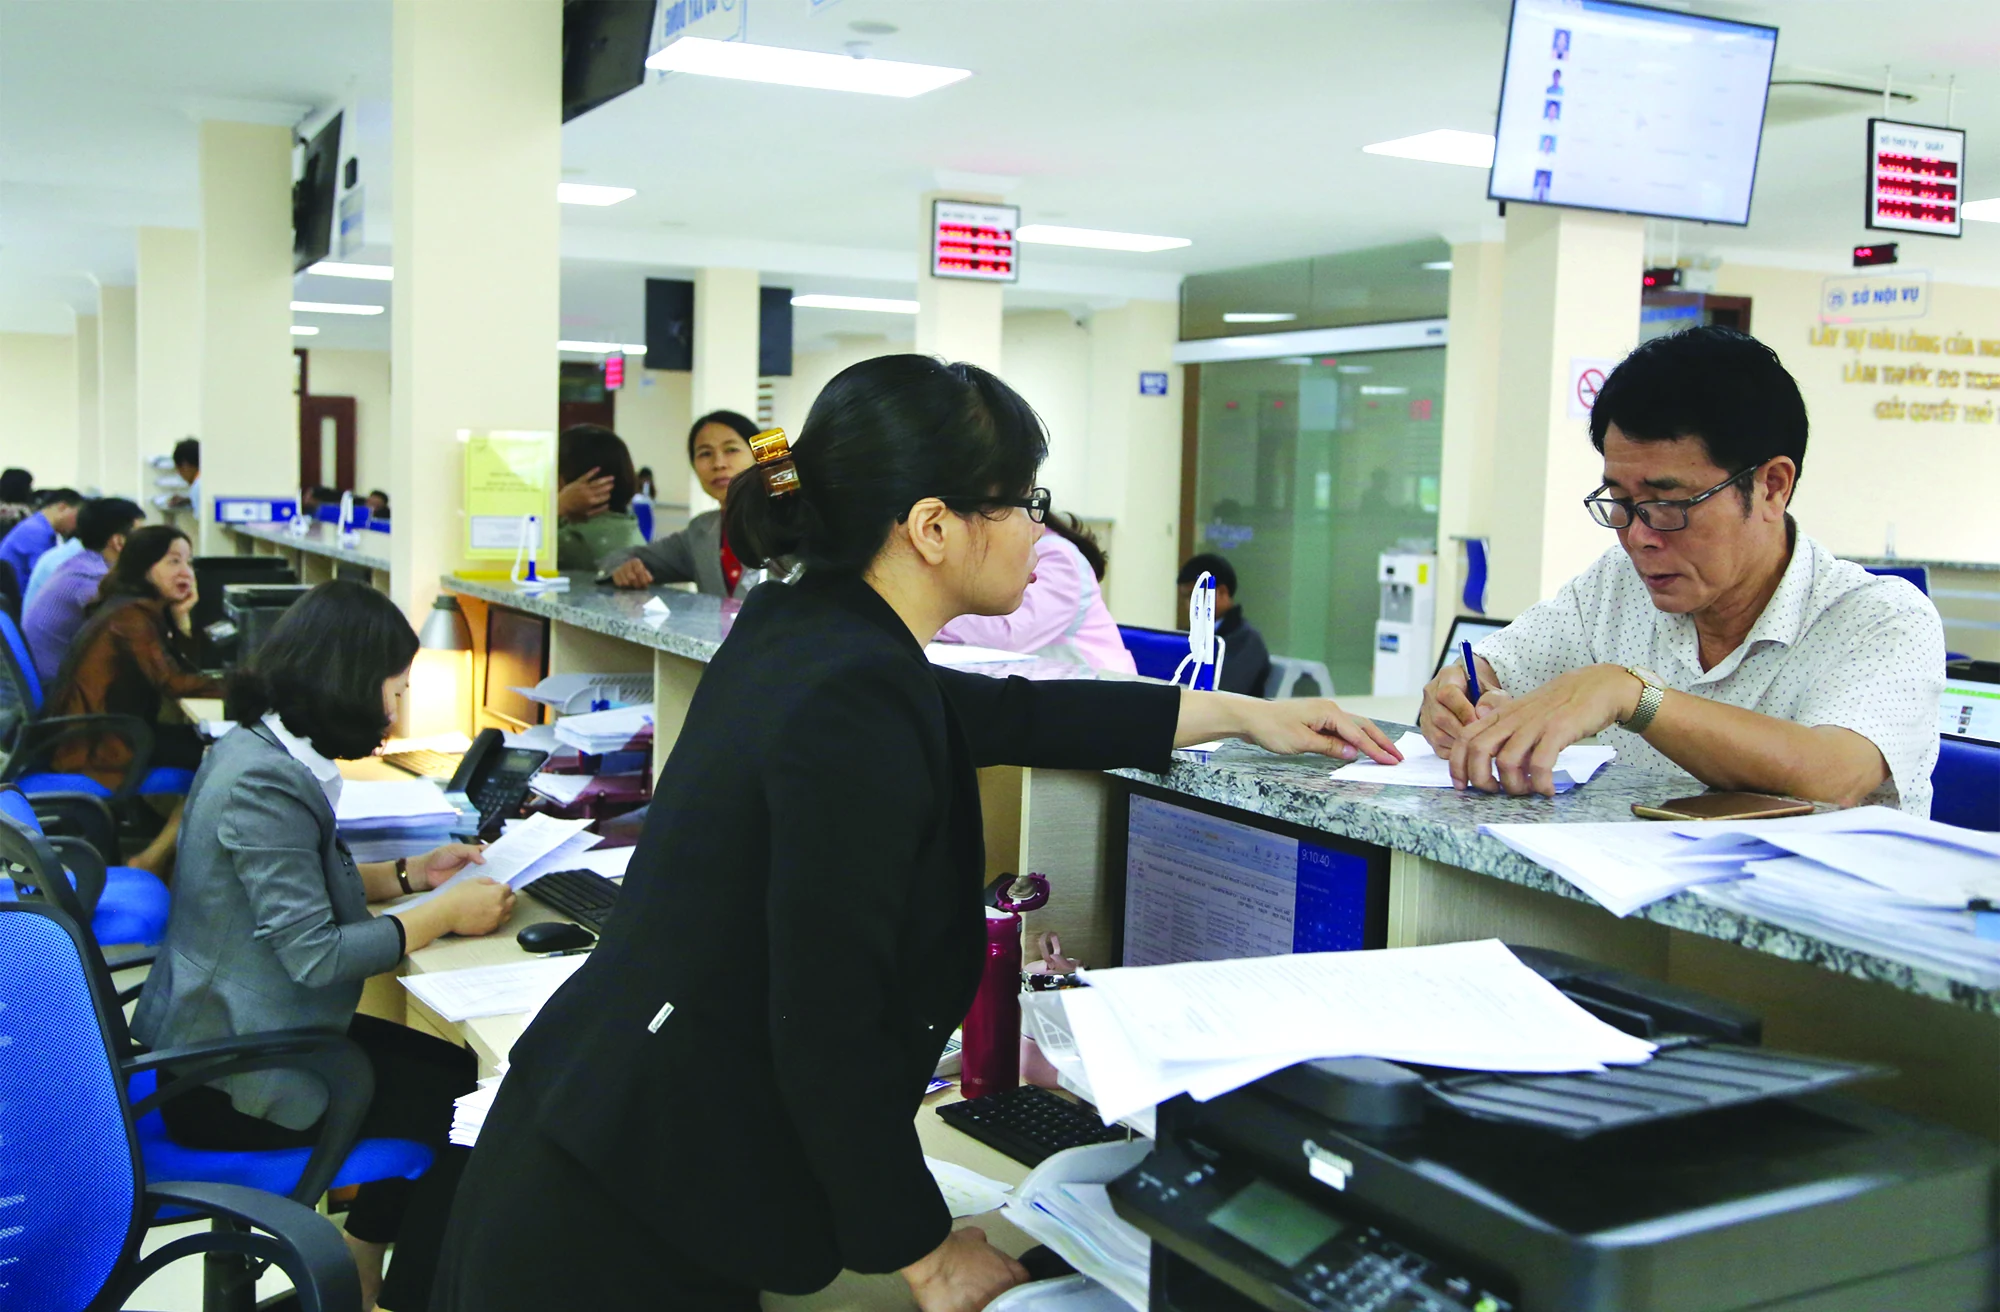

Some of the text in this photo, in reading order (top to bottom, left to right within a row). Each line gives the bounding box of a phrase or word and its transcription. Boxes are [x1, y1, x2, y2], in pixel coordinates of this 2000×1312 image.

[1852, 286, 1870, 305] SỞ
[1873, 286, 1897, 306] NỘI
[1902, 287, 1919, 303] VỤ
[1302, 849, 1330, 867] 9:10:40
